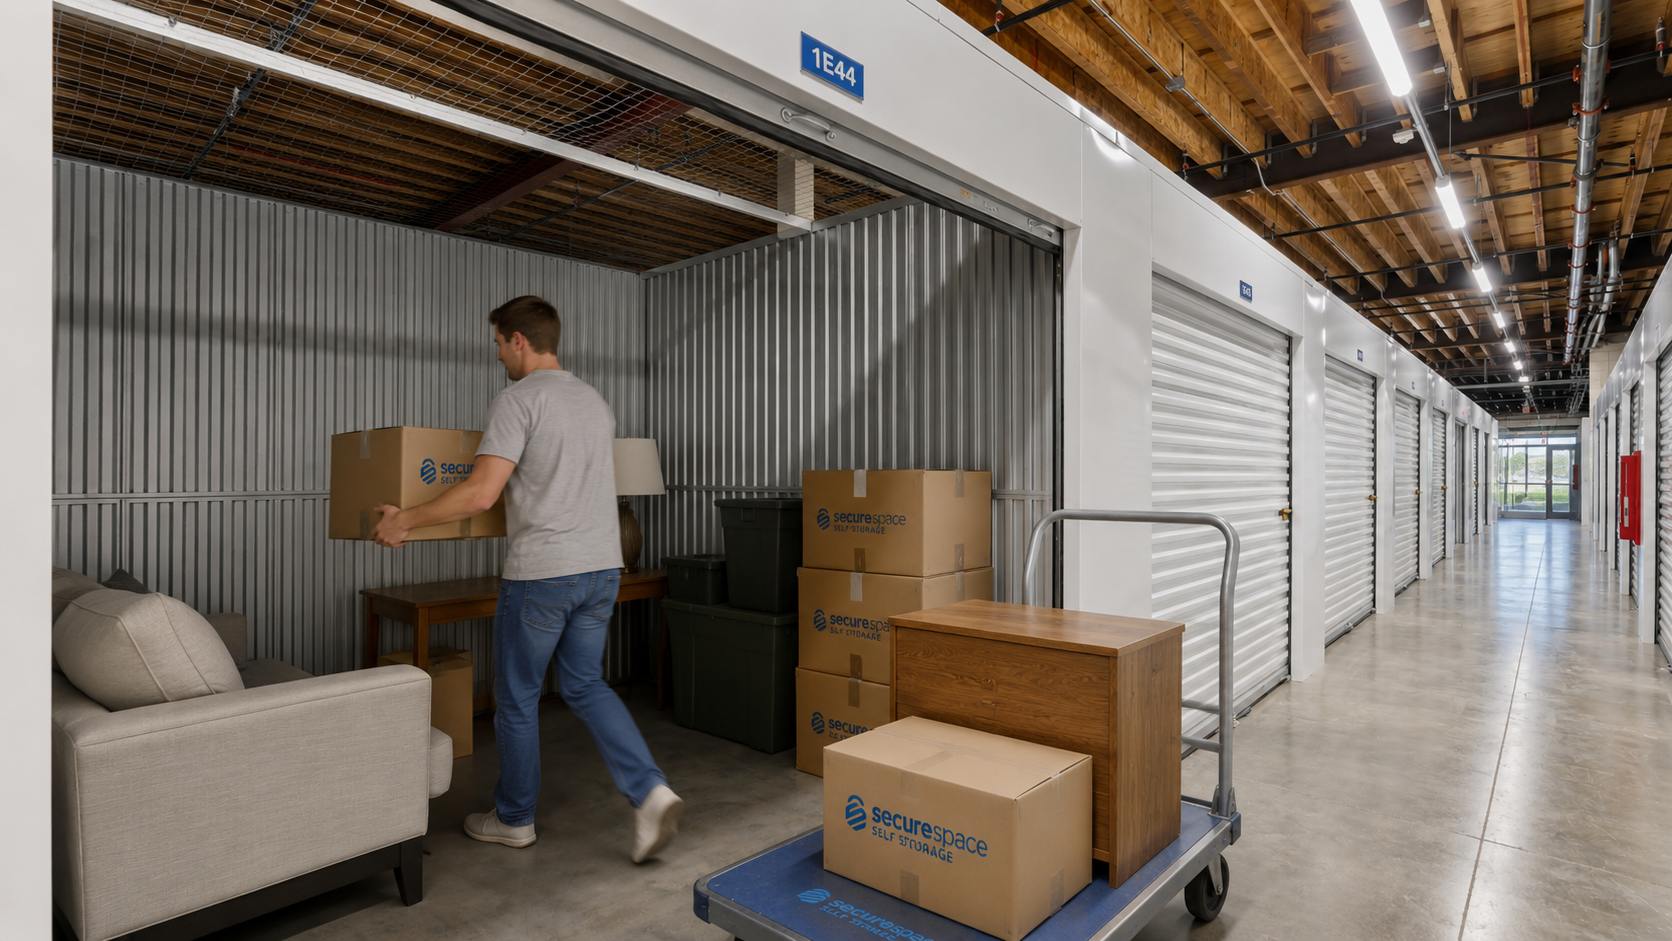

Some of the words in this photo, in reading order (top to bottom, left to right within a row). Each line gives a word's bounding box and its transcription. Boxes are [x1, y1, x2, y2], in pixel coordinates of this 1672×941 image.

[812, 47, 856, 87] 1E44
[440, 463, 475, 474] secur
[833, 512, 907, 528] securespace
[830, 614, 890, 632] securespa
[828, 719, 872, 734] secure
[871, 826, 896, 842] SELF
[872, 806, 988, 857] securespace
